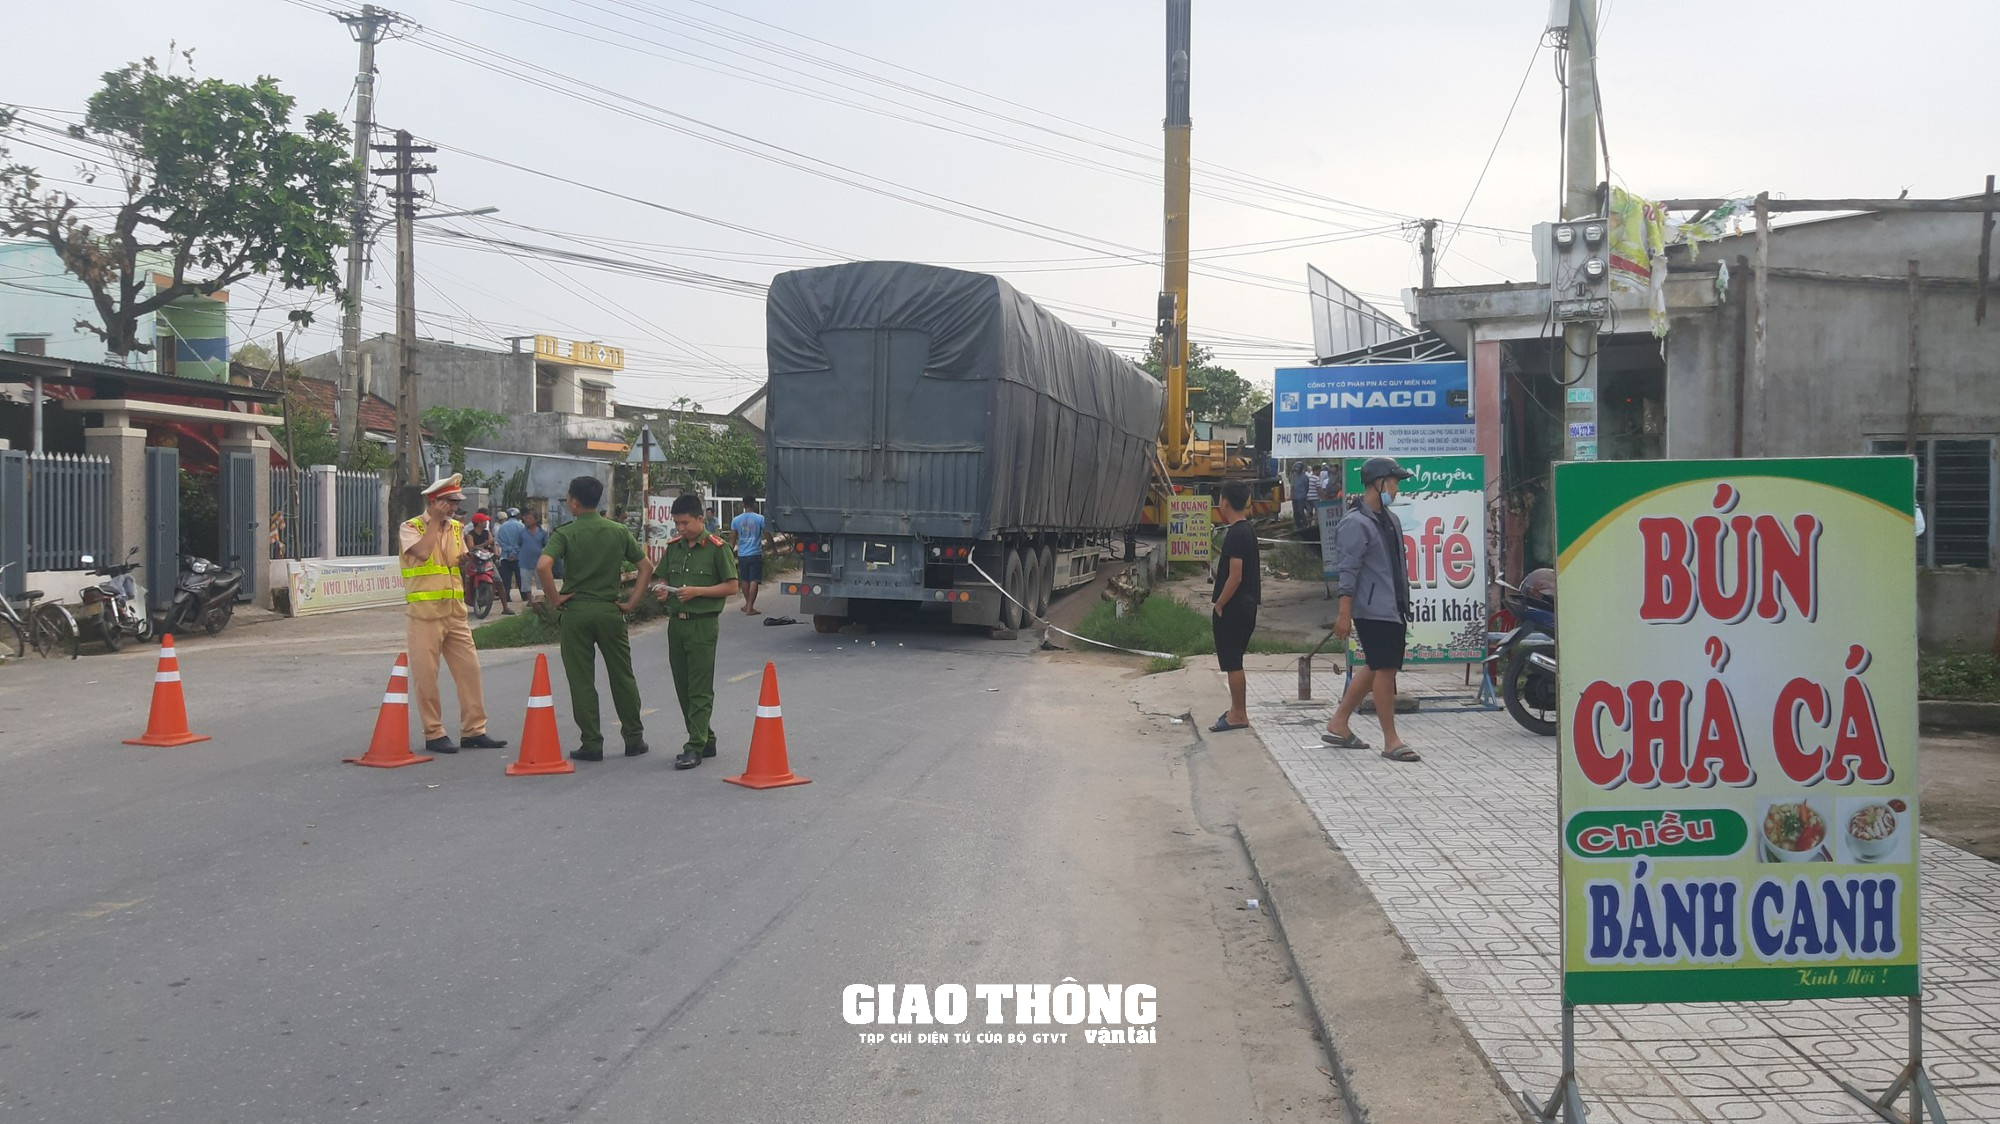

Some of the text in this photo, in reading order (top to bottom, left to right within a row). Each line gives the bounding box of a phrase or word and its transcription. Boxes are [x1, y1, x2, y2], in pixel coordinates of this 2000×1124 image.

[1306, 390, 1436, 409] PINACO
[1276, 427, 1384, 452] PHỤ TÙNG HOÀNG LIÊN
[1406, 464, 1475, 489] Nguyên
[1181, 497, 1208, 511] QUẢNG
[1171, 536, 1190, 555] BÚN
[1403, 515, 1476, 589] afé
[1638, 483, 1822, 624] BÚN
[1442, 597, 1480, 622] khát
[1573, 635, 1894, 789] CHẢ CÁ
[1576, 811, 1715, 853] Chiều
[1587, 860, 1898, 959] BÁNH CANH
